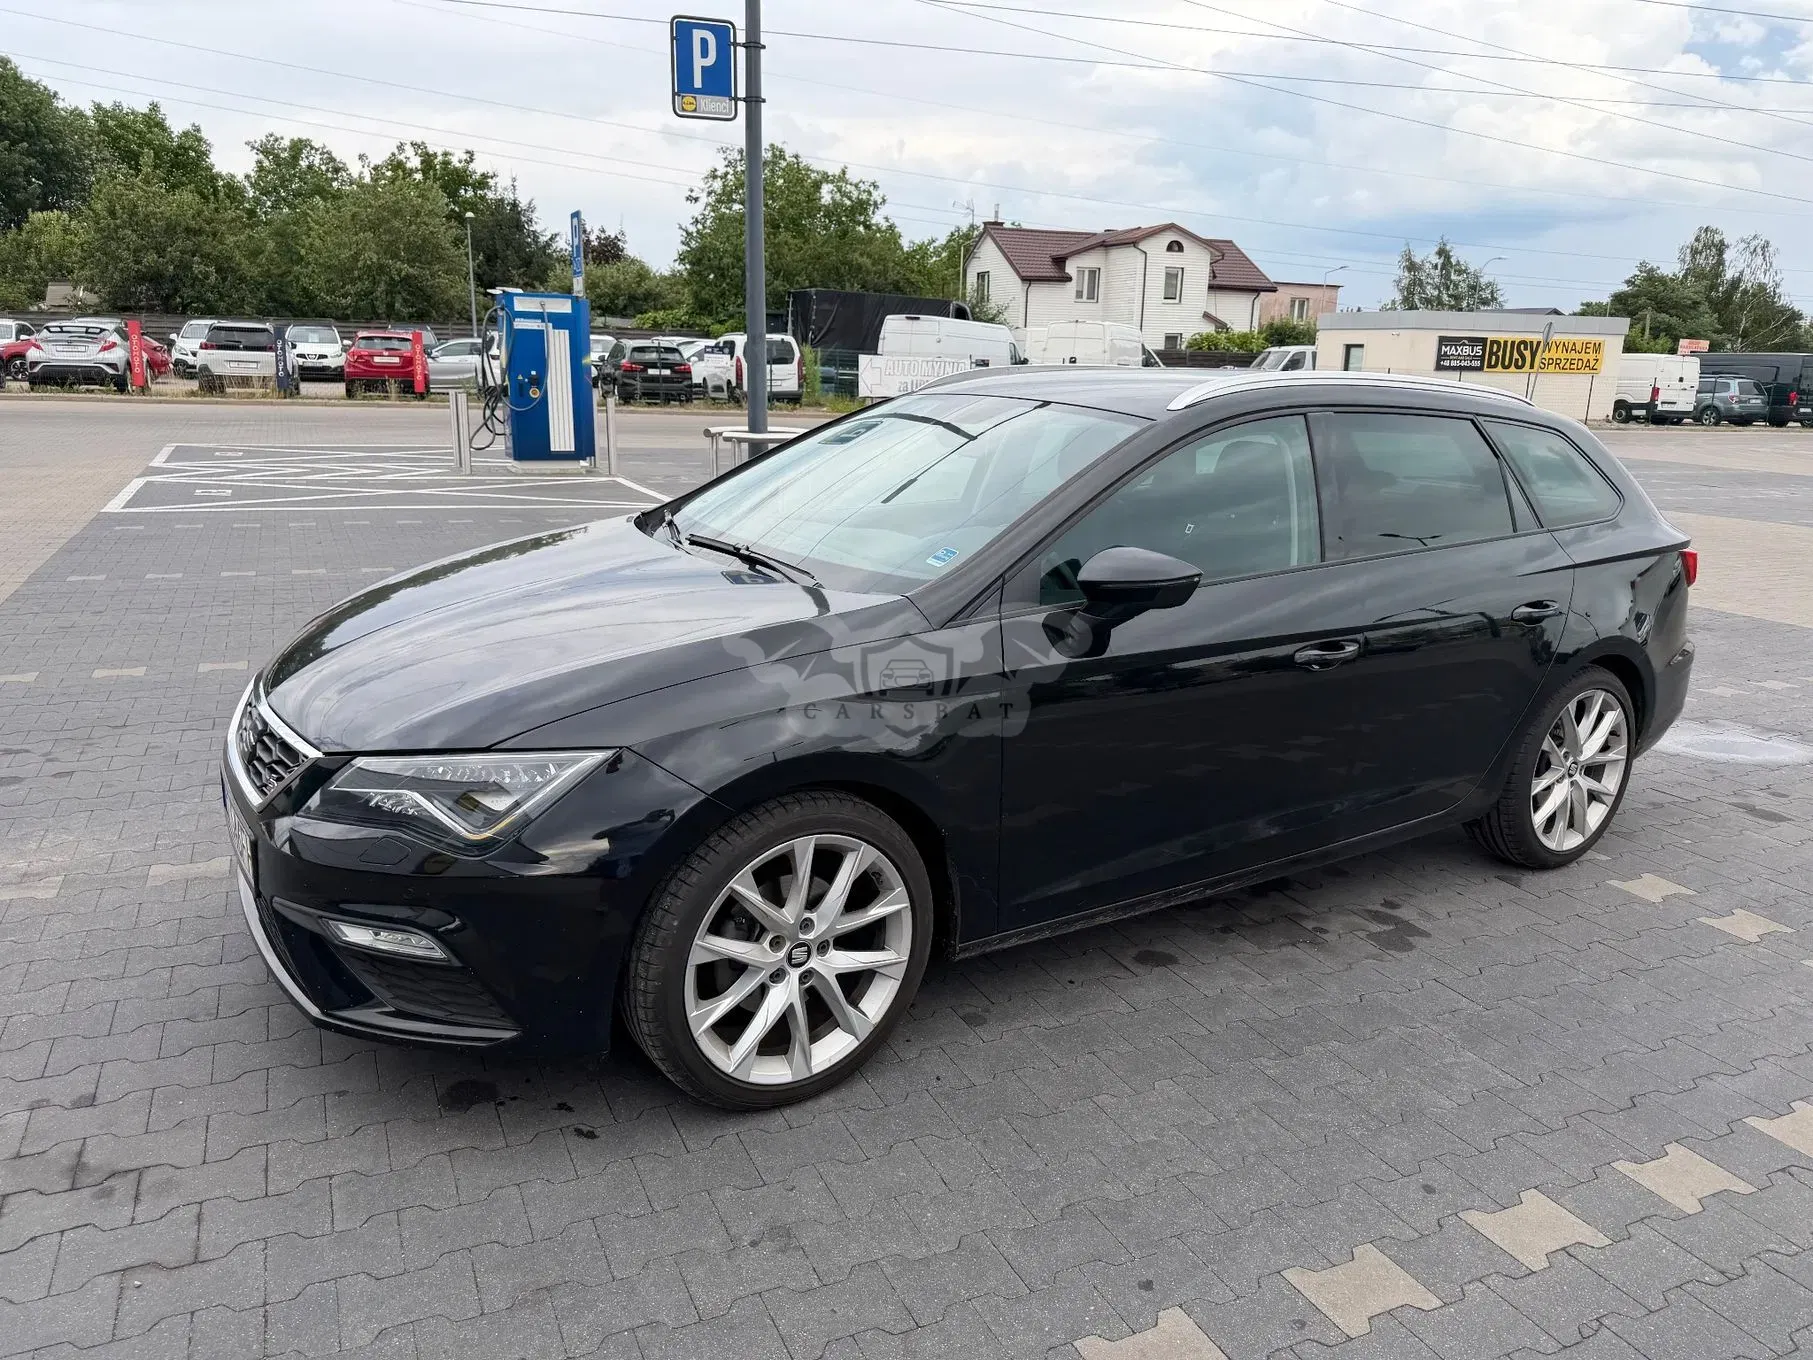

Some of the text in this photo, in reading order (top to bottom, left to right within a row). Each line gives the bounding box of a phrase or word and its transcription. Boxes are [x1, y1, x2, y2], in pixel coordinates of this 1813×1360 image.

[692, 28, 717, 89] P
[132, 334, 141, 373] OTOMOTO
[277, 339, 285, 377] OTOMOTO
[415, 344, 423, 381] OTOMOTO
[1441, 345, 1483, 355] MAXBUS
[1486, 340, 1542, 370] BUSY
[1539, 355, 1600, 370] SPRZEDAŻ
